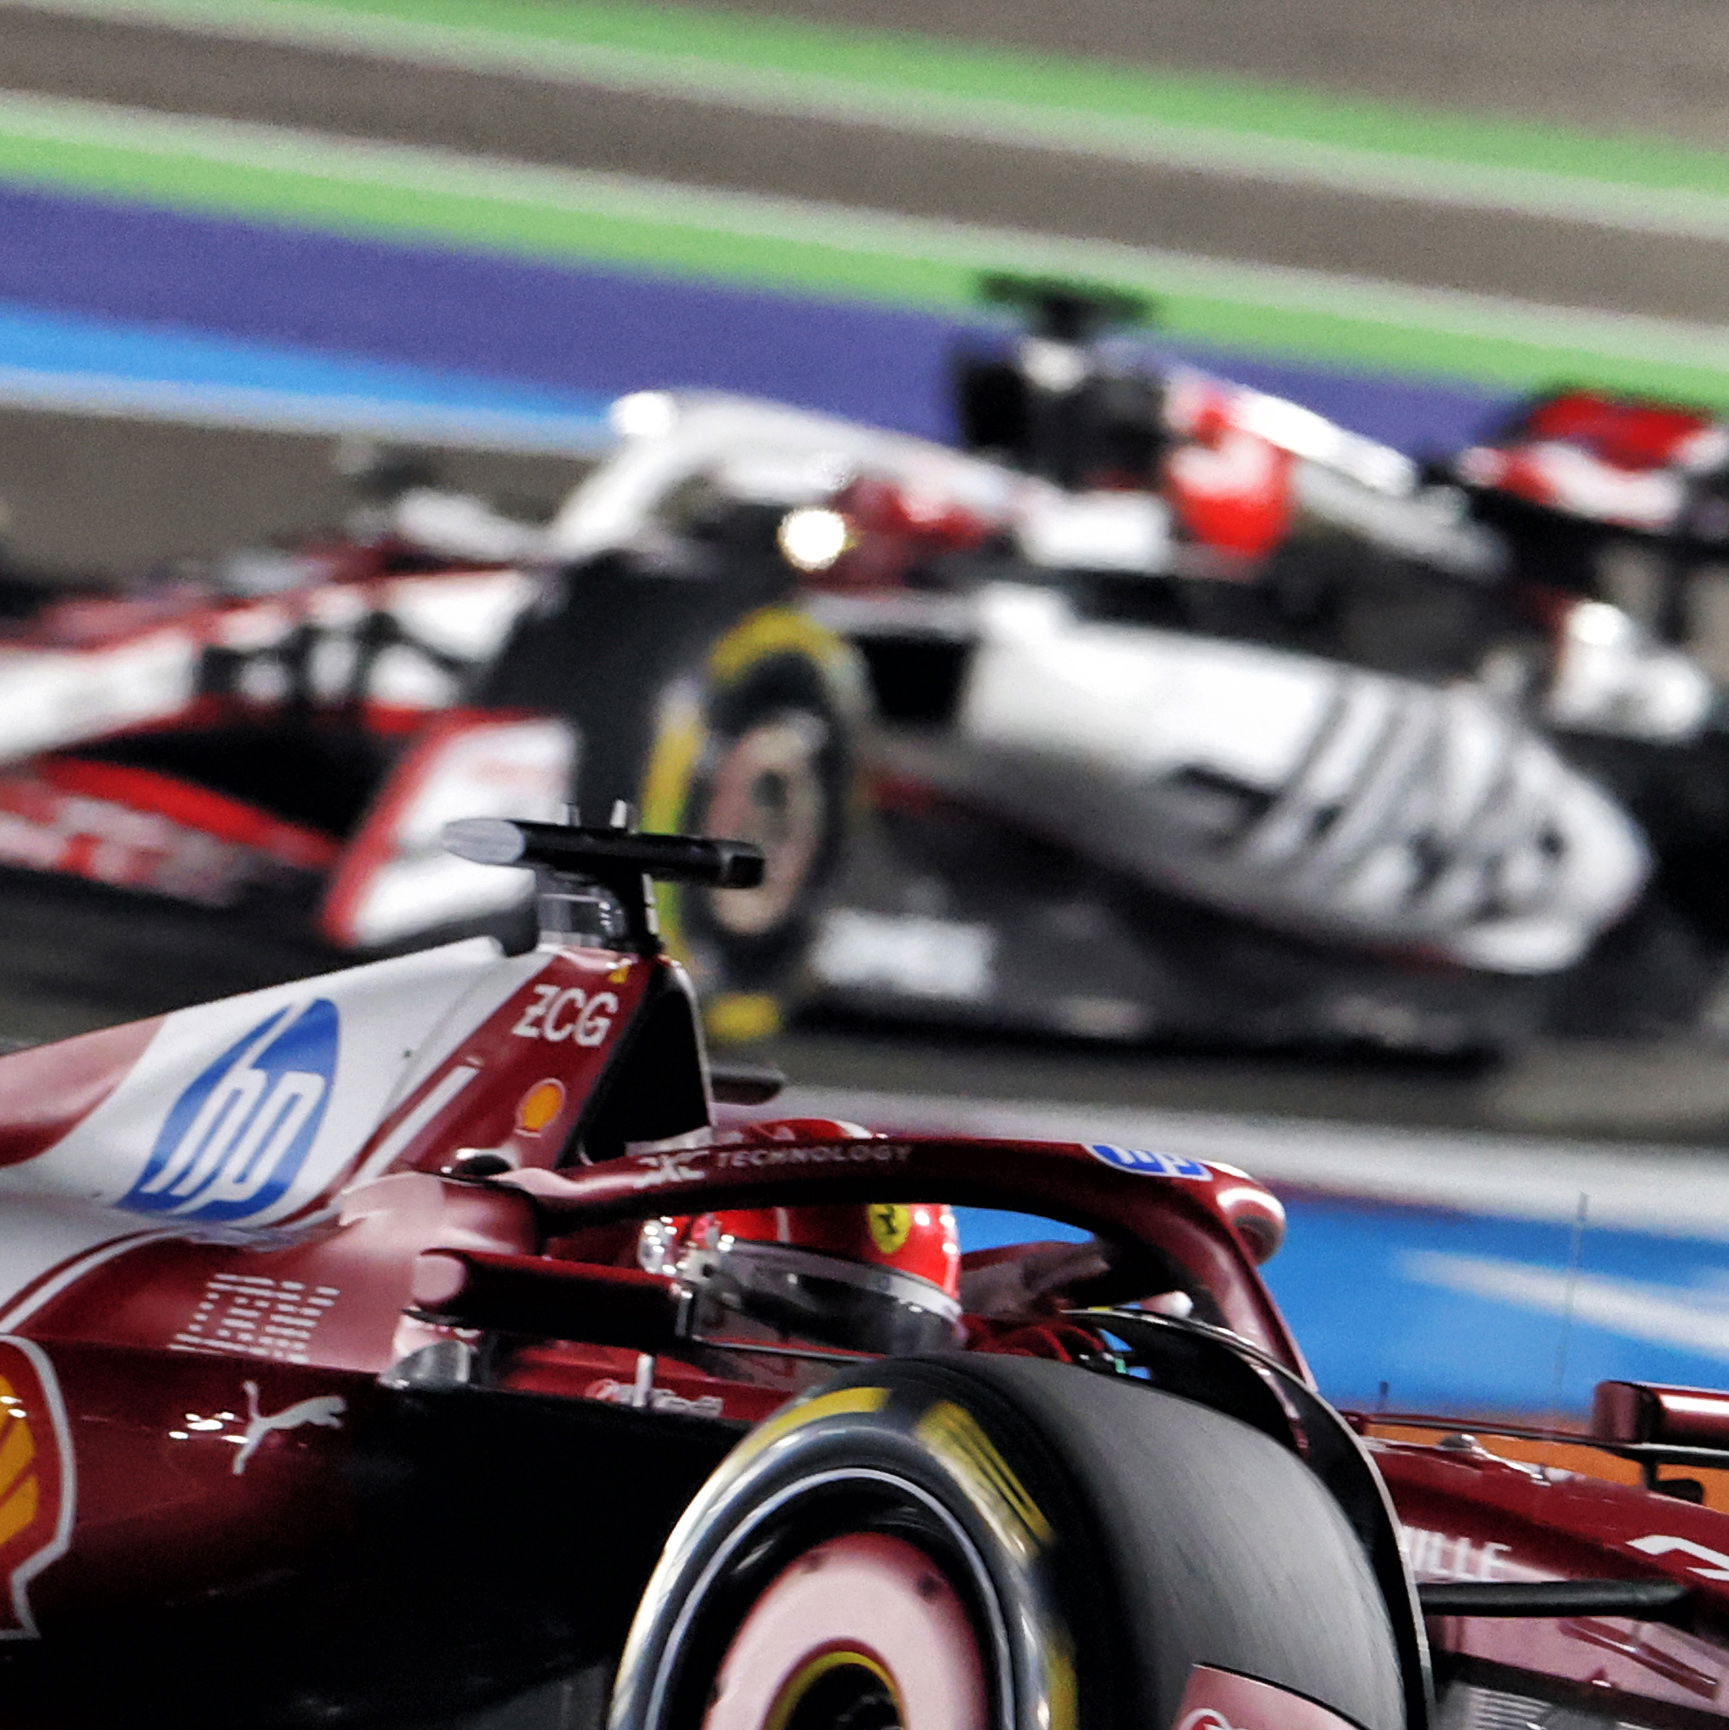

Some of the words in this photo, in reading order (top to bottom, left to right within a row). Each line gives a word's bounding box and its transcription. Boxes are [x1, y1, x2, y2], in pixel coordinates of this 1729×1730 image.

[511, 983, 620, 1047] ZCG
[134, 1000, 328, 1217] hp
[717, 1146, 912, 1169] TECHNOLOGY
